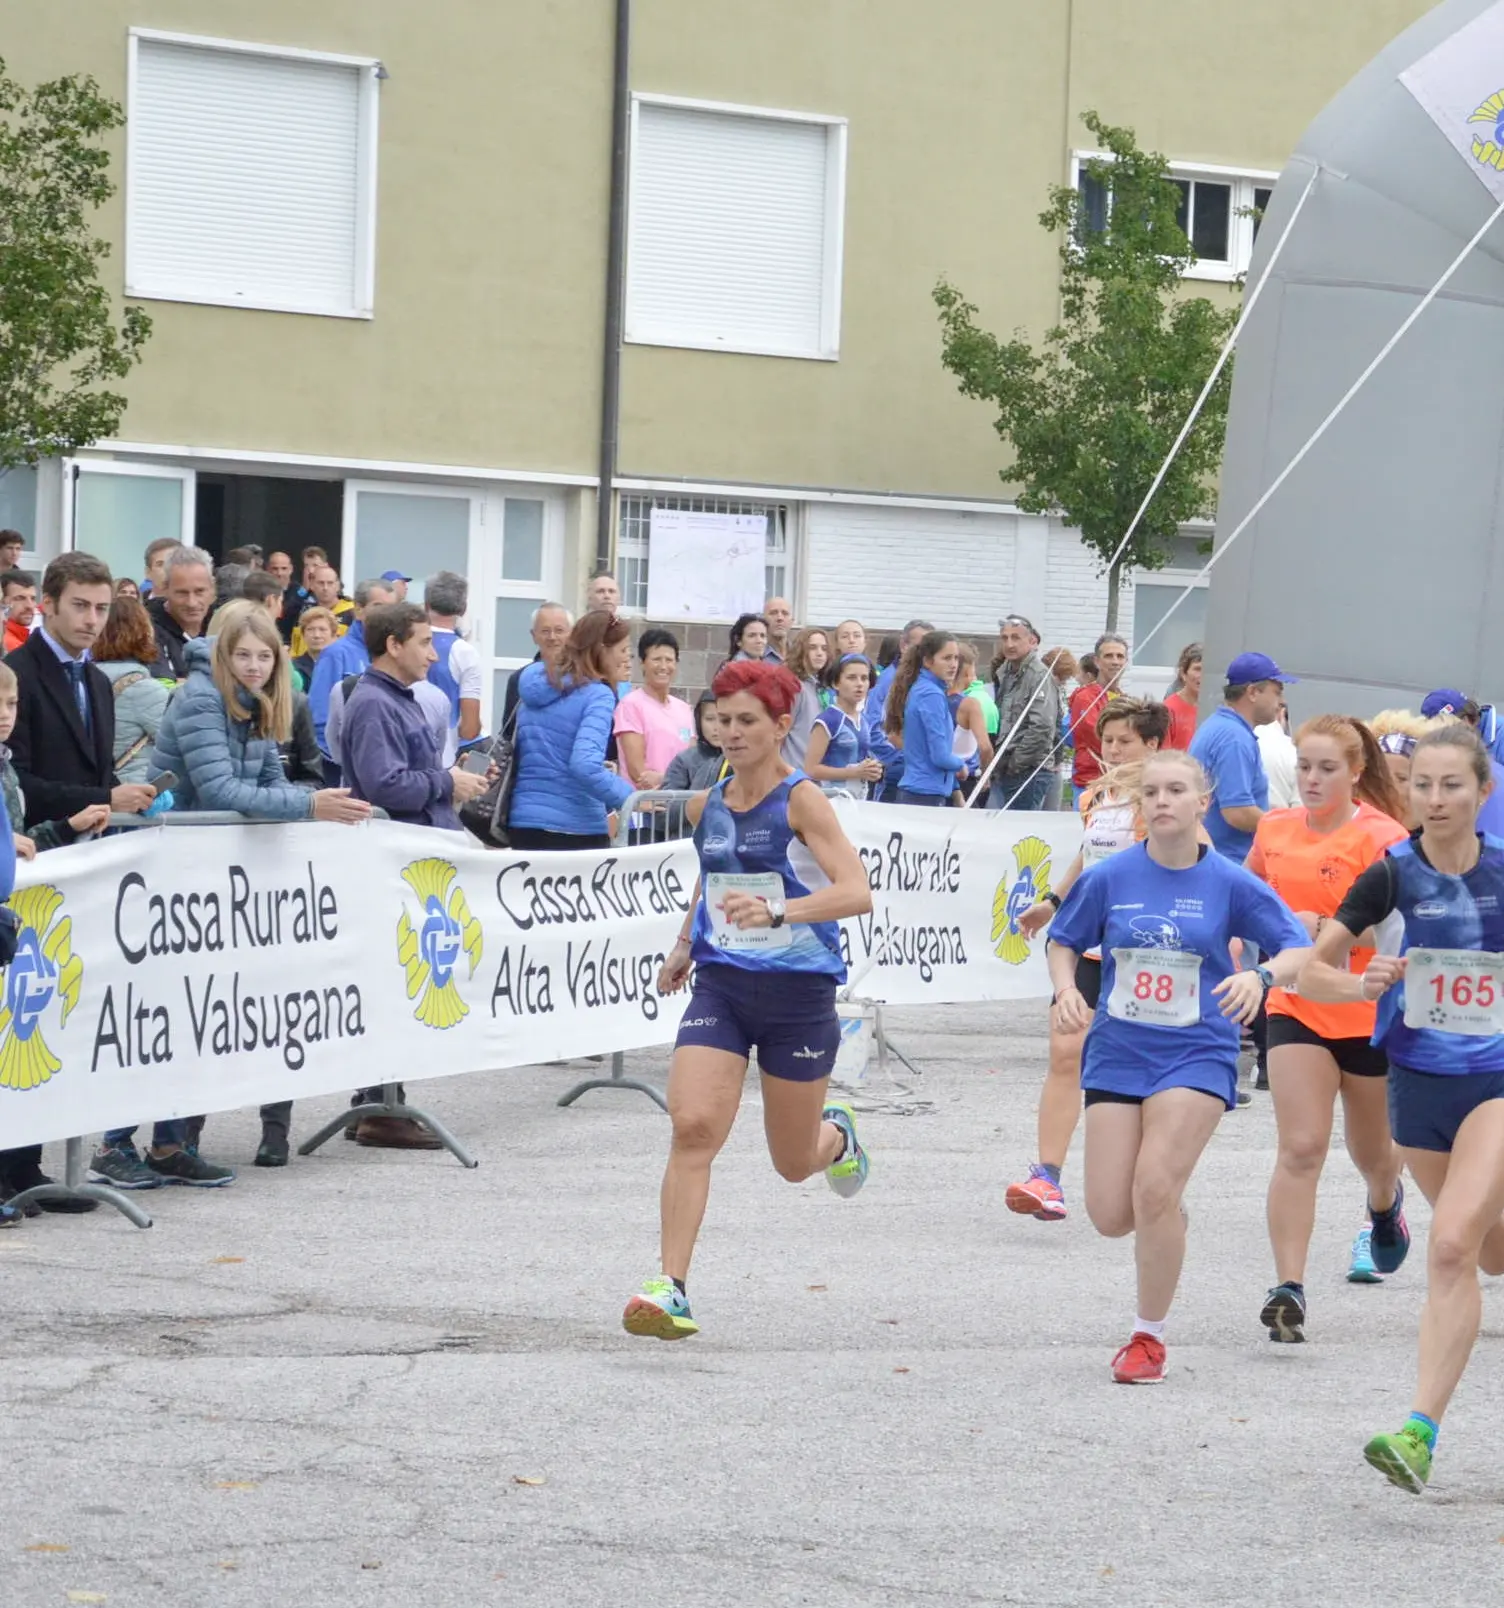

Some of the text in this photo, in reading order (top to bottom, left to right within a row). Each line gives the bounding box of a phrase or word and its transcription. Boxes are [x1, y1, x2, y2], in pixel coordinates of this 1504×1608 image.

[496, 853, 690, 930] Cassa Rurale
[886, 832, 961, 893] Rurale
[114, 860, 338, 965] Cassa Rurale
[858, 906, 967, 983] Valsugana
[491, 938, 696, 1021] Alta Valsug
[1133, 970, 1174, 1003] 88
[1429, 973, 1495, 1008] 165
[91, 971, 366, 1072] Alta Valsugana
